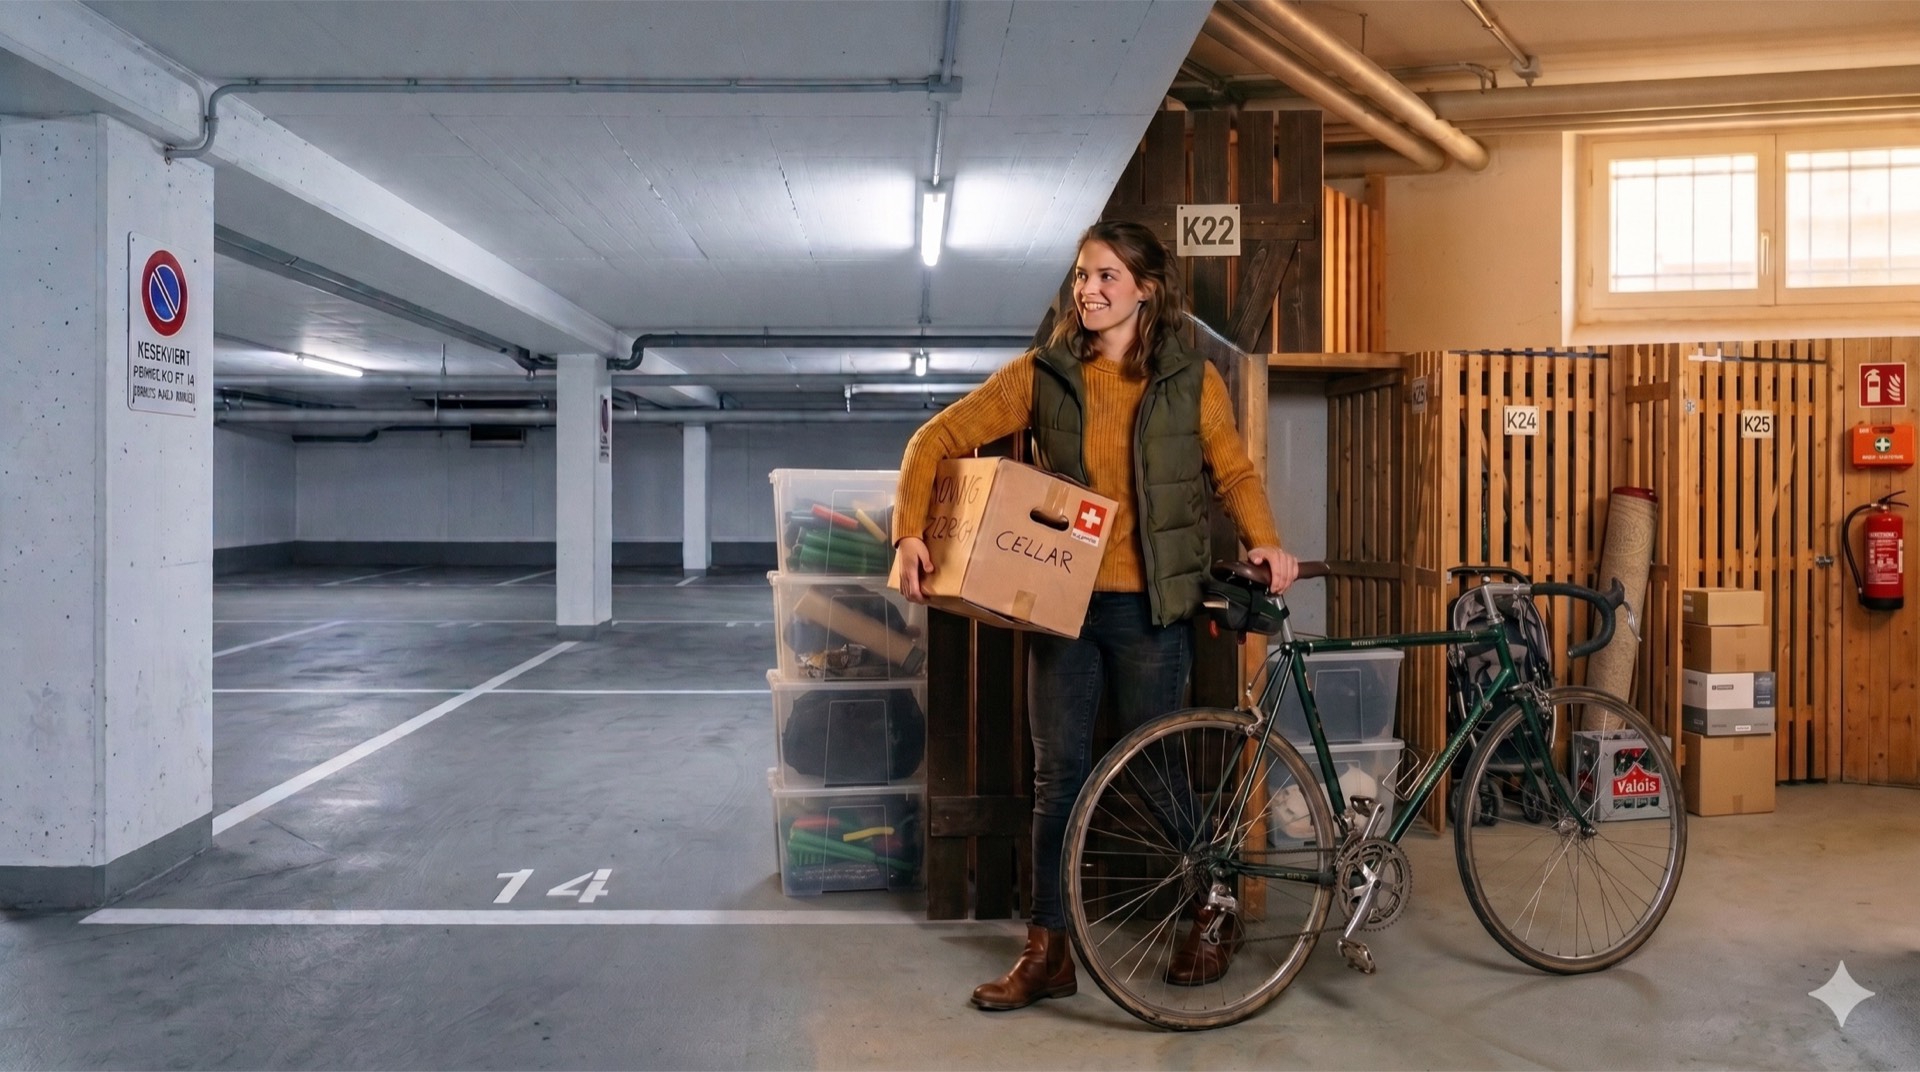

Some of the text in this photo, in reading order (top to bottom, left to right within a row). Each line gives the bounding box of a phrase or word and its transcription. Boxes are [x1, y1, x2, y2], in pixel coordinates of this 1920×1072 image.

[1183, 216, 1234, 246] K22
[1508, 411, 1536, 429] K24
[1744, 415, 1770, 433] K25
[996, 530, 1073, 574] CELLAR
[1617, 778, 1657, 794] Valois
[493, 868, 613, 903] 14
